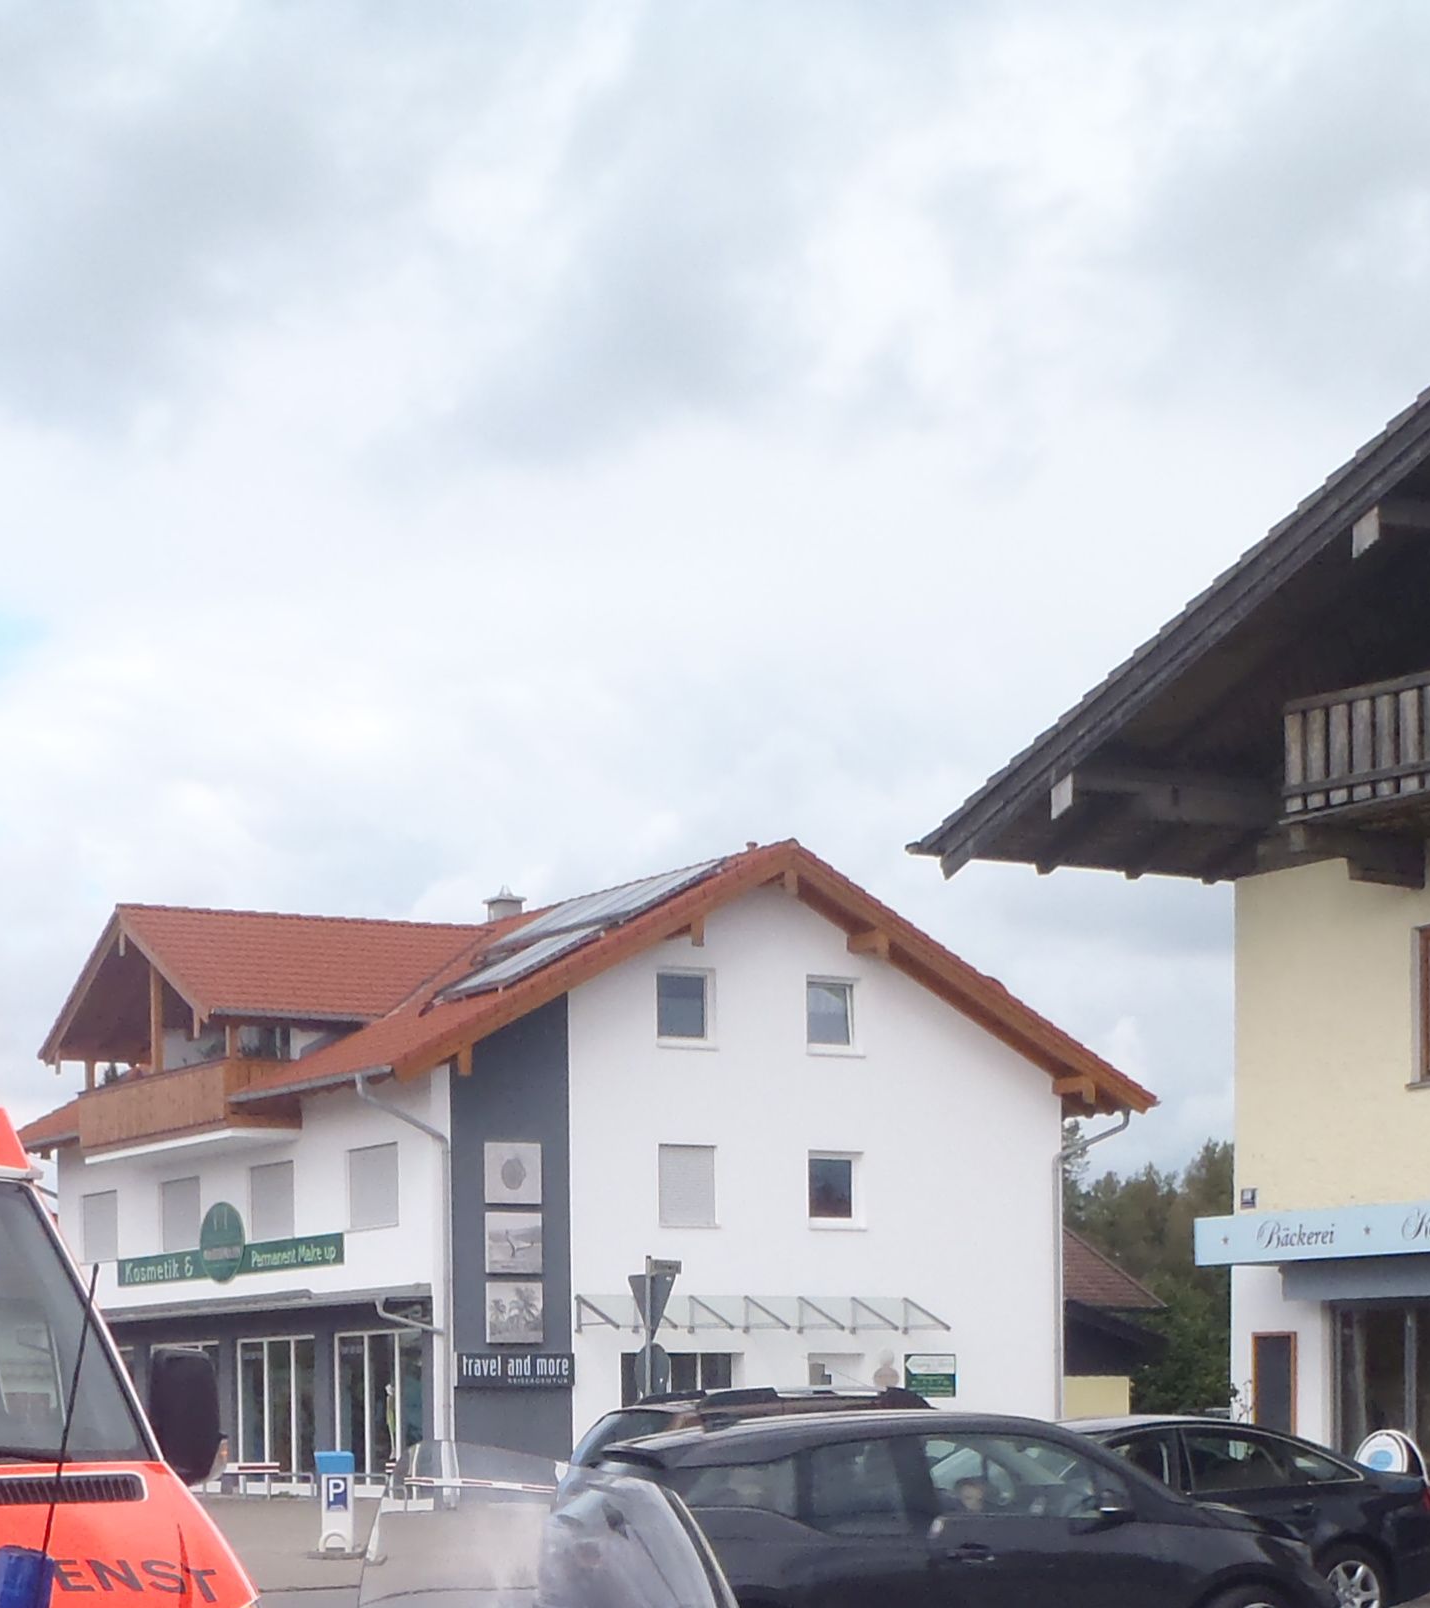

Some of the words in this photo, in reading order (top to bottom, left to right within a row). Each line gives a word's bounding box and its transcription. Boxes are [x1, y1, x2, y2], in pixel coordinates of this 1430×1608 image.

[1255, 1219, 1336, 1249] Bäckerei
[251, 1247, 296, 1268] Permanent
[298, 1244, 323, 1263] Make
[324, 1245, 337, 1264] up
[125, 1256, 180, 1283] Kosmetik
[184, 1256, 194, 1278] &
[462, 1355, 502, 1376] travel
[507, 1355, 531, 1376] and
[536, 1358, 569, 1376] more
[328, 1479, 345, 1502] P
